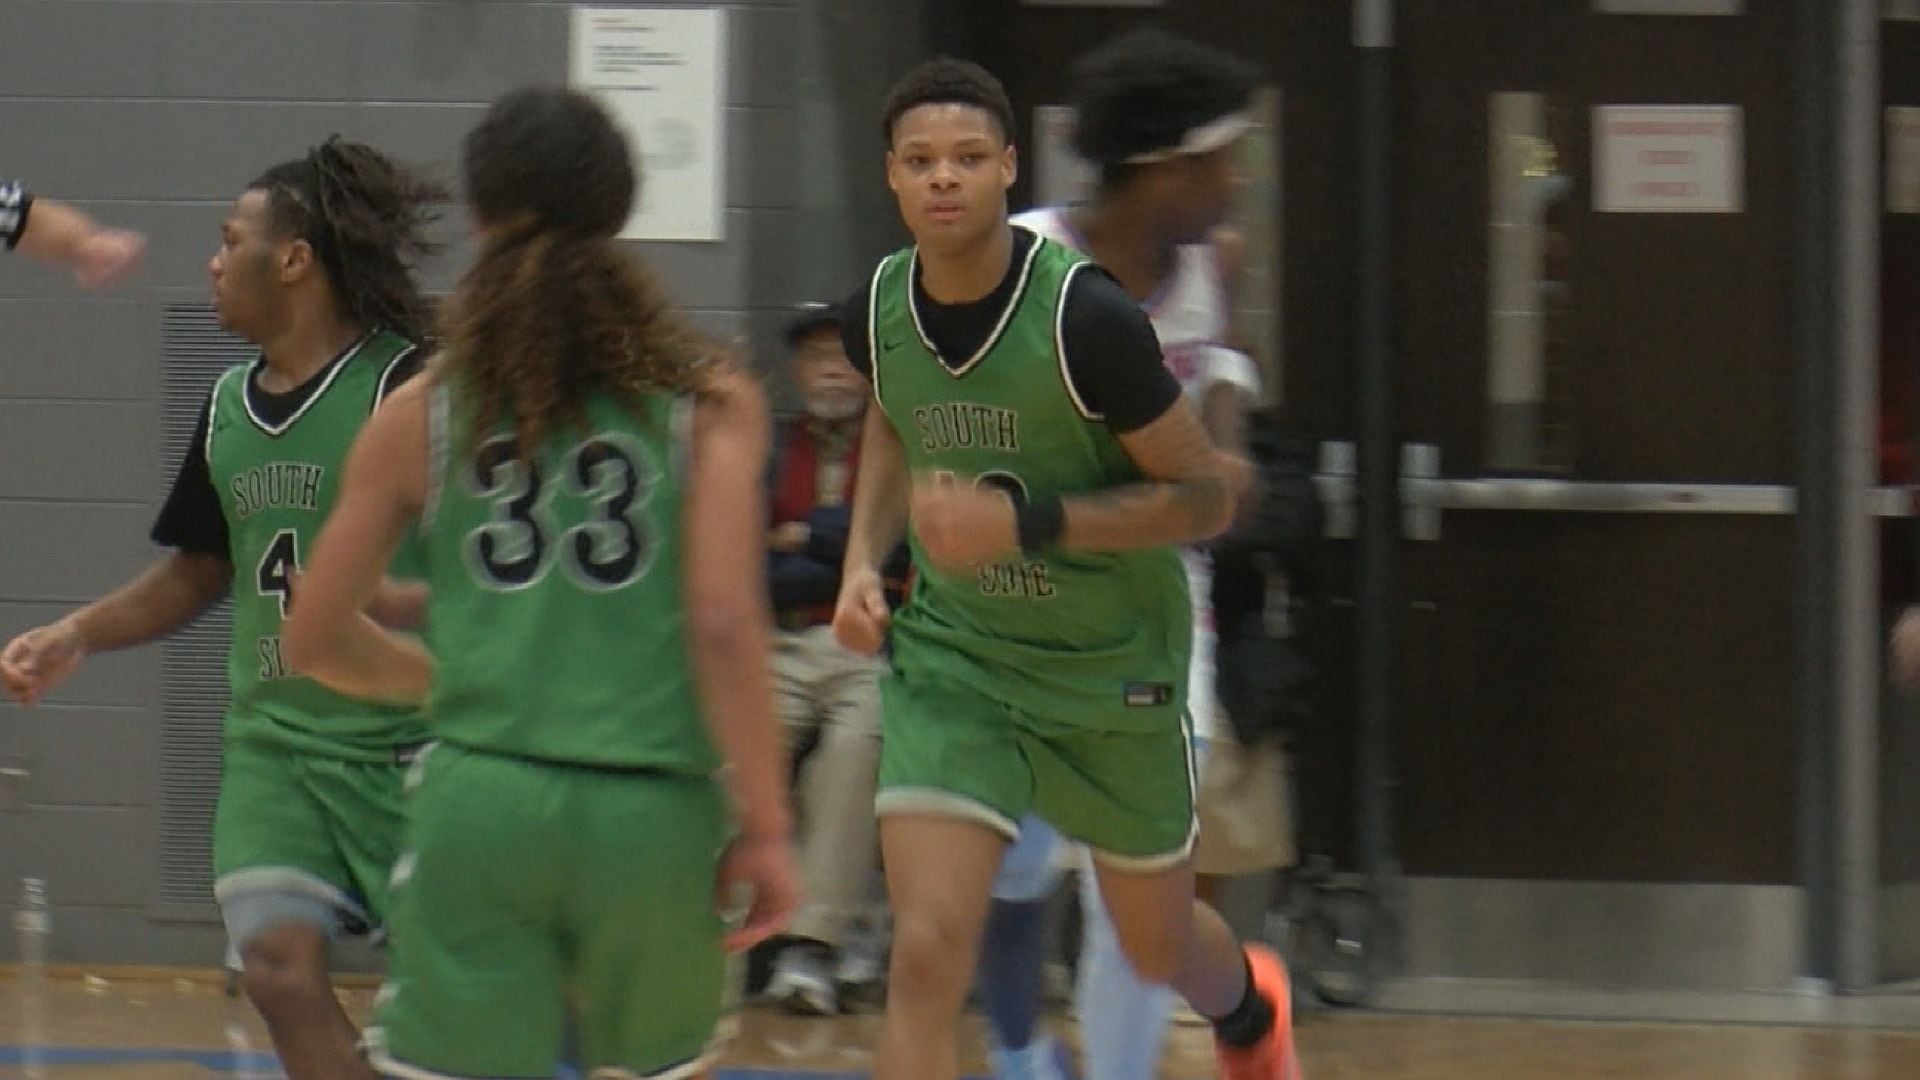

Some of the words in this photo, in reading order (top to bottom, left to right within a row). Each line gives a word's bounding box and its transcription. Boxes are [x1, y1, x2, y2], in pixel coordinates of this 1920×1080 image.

[914, 402, 1019, 452] SOUTH
[231, 461, 324, 519] SOUTH
[461, 433, 659, 592] 33
[256, 528, 301, 621] 4
